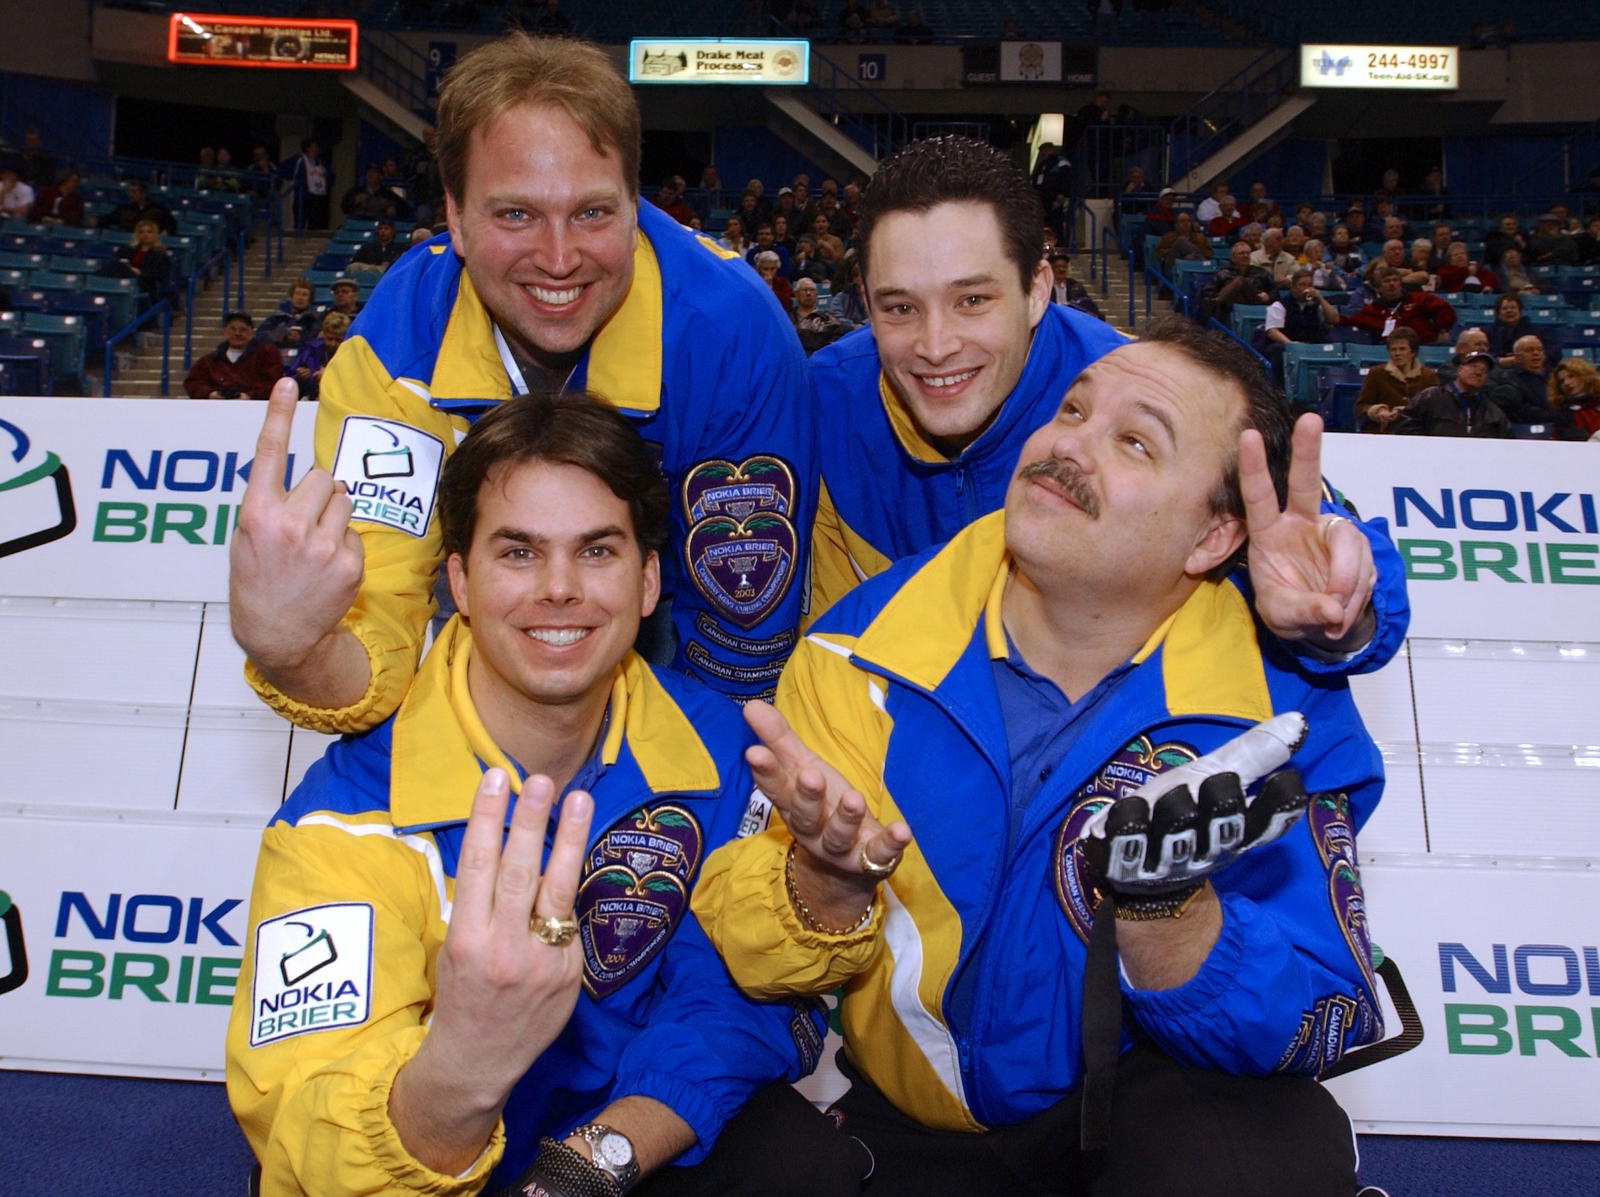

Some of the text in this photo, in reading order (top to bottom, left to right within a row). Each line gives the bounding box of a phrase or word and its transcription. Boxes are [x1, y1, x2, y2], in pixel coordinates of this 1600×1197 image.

[215, 24, 261, 34] Canadian
[264, 26, 312, 36] Industries
[696, 50, 764, 60] Drake Meat
[696, 61, 763, 70] Processs
[1367, 53, 1449, 69] 244-4997
[860, 61, 878, 79] 10
[967, 72, 997, 82] GUEST
[1067, 73, 1093, 82] HOME
[101, 449, 296, 492] NOKI
[706, 487, 772, 501] NOKIA BRIER
[352, 499, 420, 530] RIER
[1392, 486, 1599, 534] NOKI
[92, 501, 241, 545] BRI
[709, 543, 775, 557] NOKIA BRIER
[1397, 538, 1600, 585] BRIE
[734, 588, 756, 599] 2003
[702, 622, 788, 652] CANADIAN CHAMPIONS
[693, 652, 732, 676] CANADIAN
[1106, 764, 1144, 783] NOKIA
[611, 834, 679, 854] NOKIA BRIER
[1065, 854, 1081, 899] CANADIAN
[54, 891, 245, 946] NOK
[600, 902, 665, 918] NOKIA BRIER
[46, 949, 243, 1006] BRIE
[260, 979, 361, 1017] NOKIA
[257, 1001, 358, 1039] BRIER
[1326, 1006, 1343, 1062] CANADIAN
